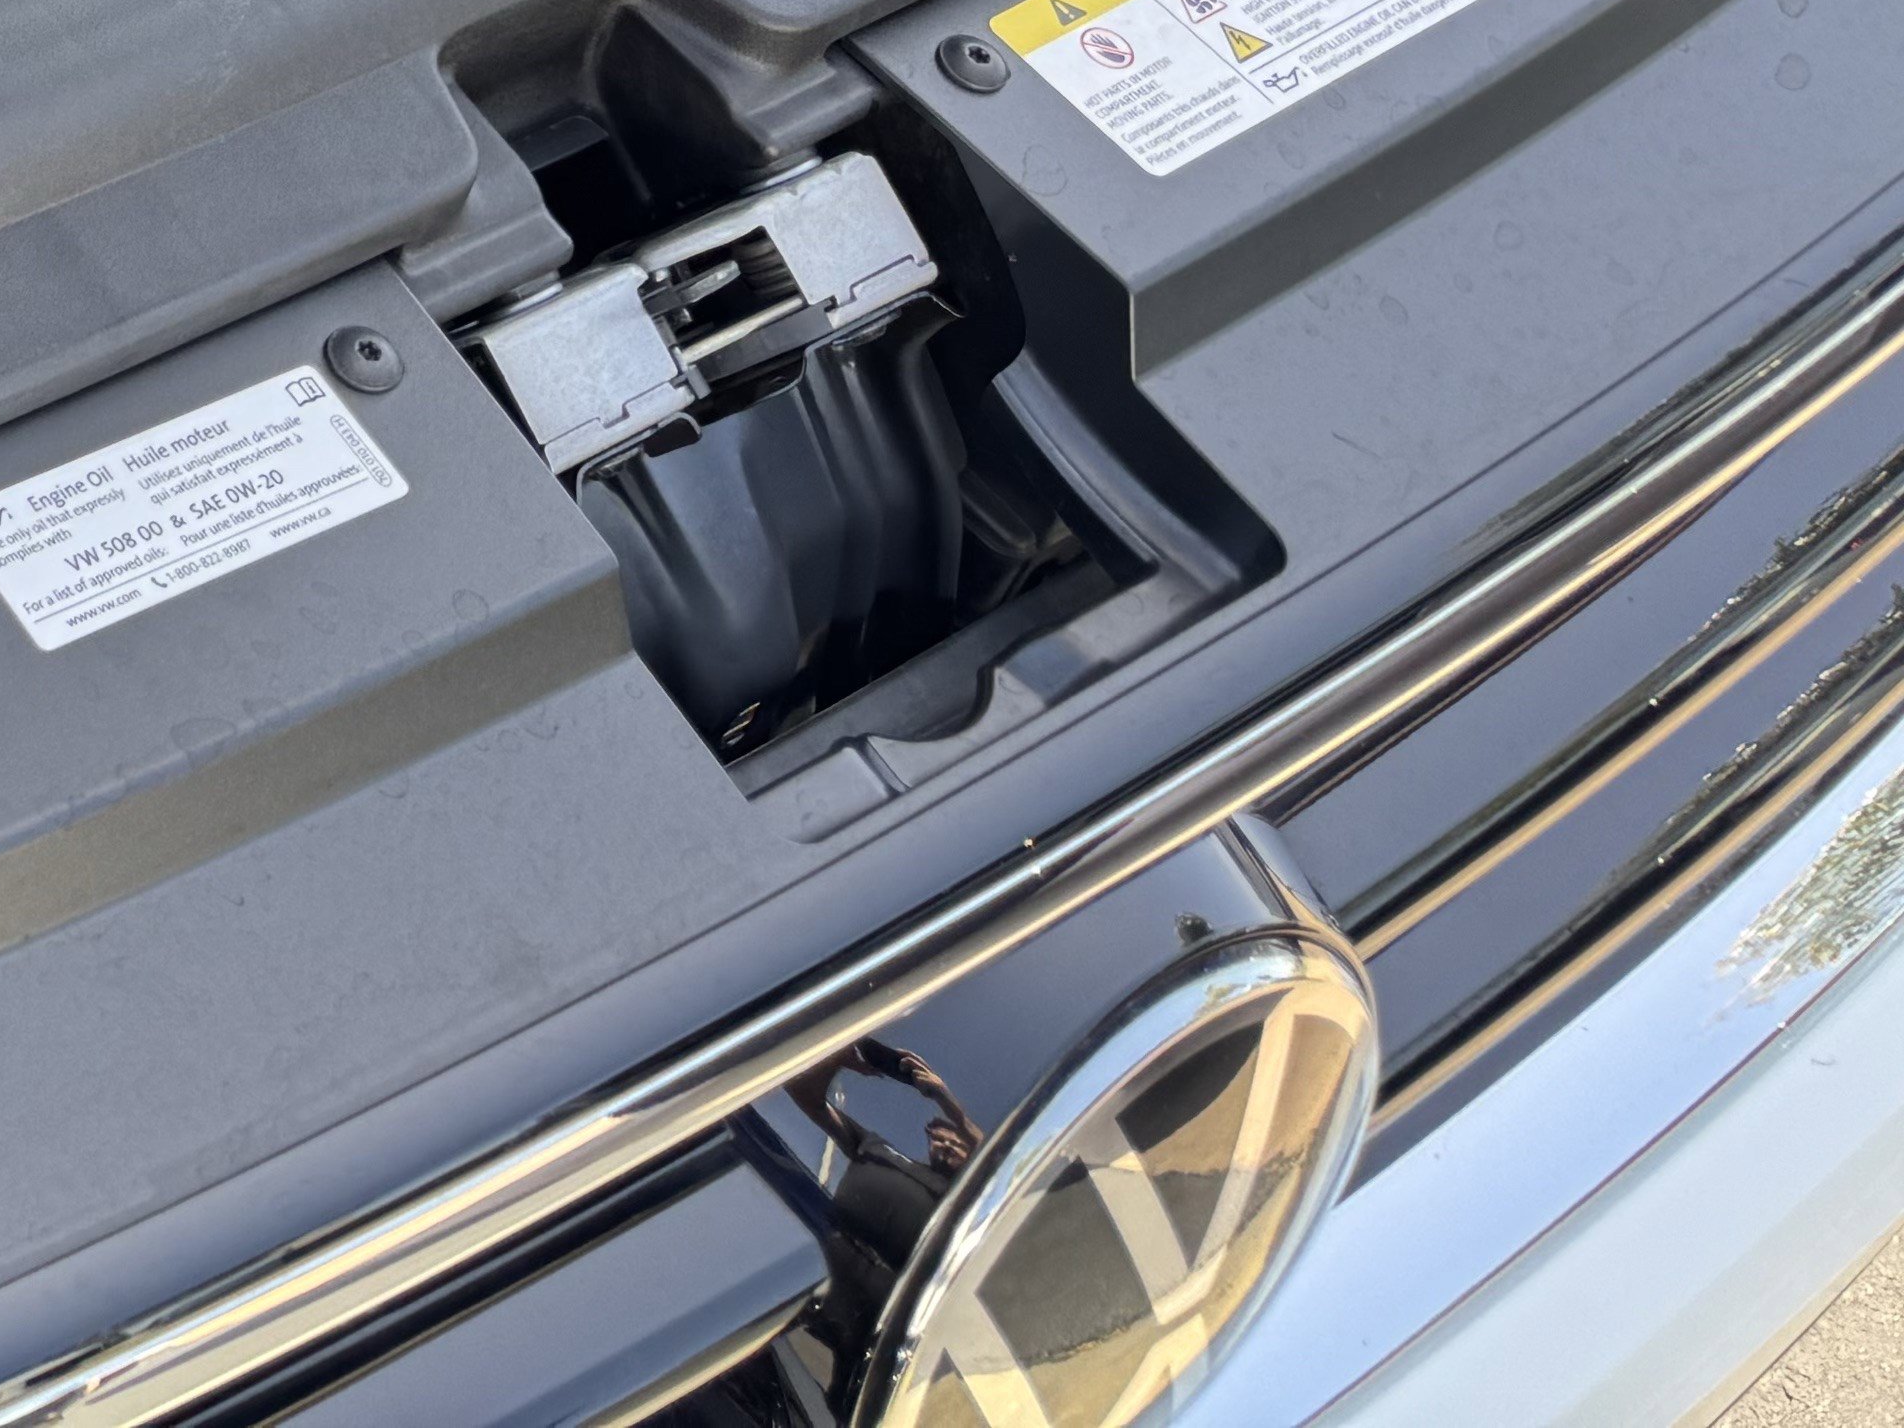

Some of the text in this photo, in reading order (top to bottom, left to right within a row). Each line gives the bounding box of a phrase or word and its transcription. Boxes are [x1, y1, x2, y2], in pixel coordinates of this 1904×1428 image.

[1080, 55, 1175, 110] HOT PARTS IN MOTOR
[120, 416, 233, 473] Huile moteur
[136, 413, 303, 491] Utilisez uniquement de l'huile
[25, 464, 115, 517] Engine Oil
[28, 518, 50, 535] oil
[43, 507, 76, 529] that
[70, 487, 129, 520] expressly
[146, 486, 174, 507] qui
[167, 467, 219, 498] satisfait
[42, 527, 74, 549] with
[62, 467, 287, 573] VW 508 00 & SAE 0W-20
[179, 526, 212, 549] Pour
[204, 516, 235, 538] une
[228, 506, 258, 528] liste
[251, 487, 301, 518] d'huiles
[21, 596, 48, 618] For
[41, 591, 59, 610] a
[51, 583, 79, 605] list
[71, 577, 92, 597] of
[84, 554, 146, 591] approved
[63, 503, 332, 629] www.vw.com 1-800-822-8987 www.vw.ca
